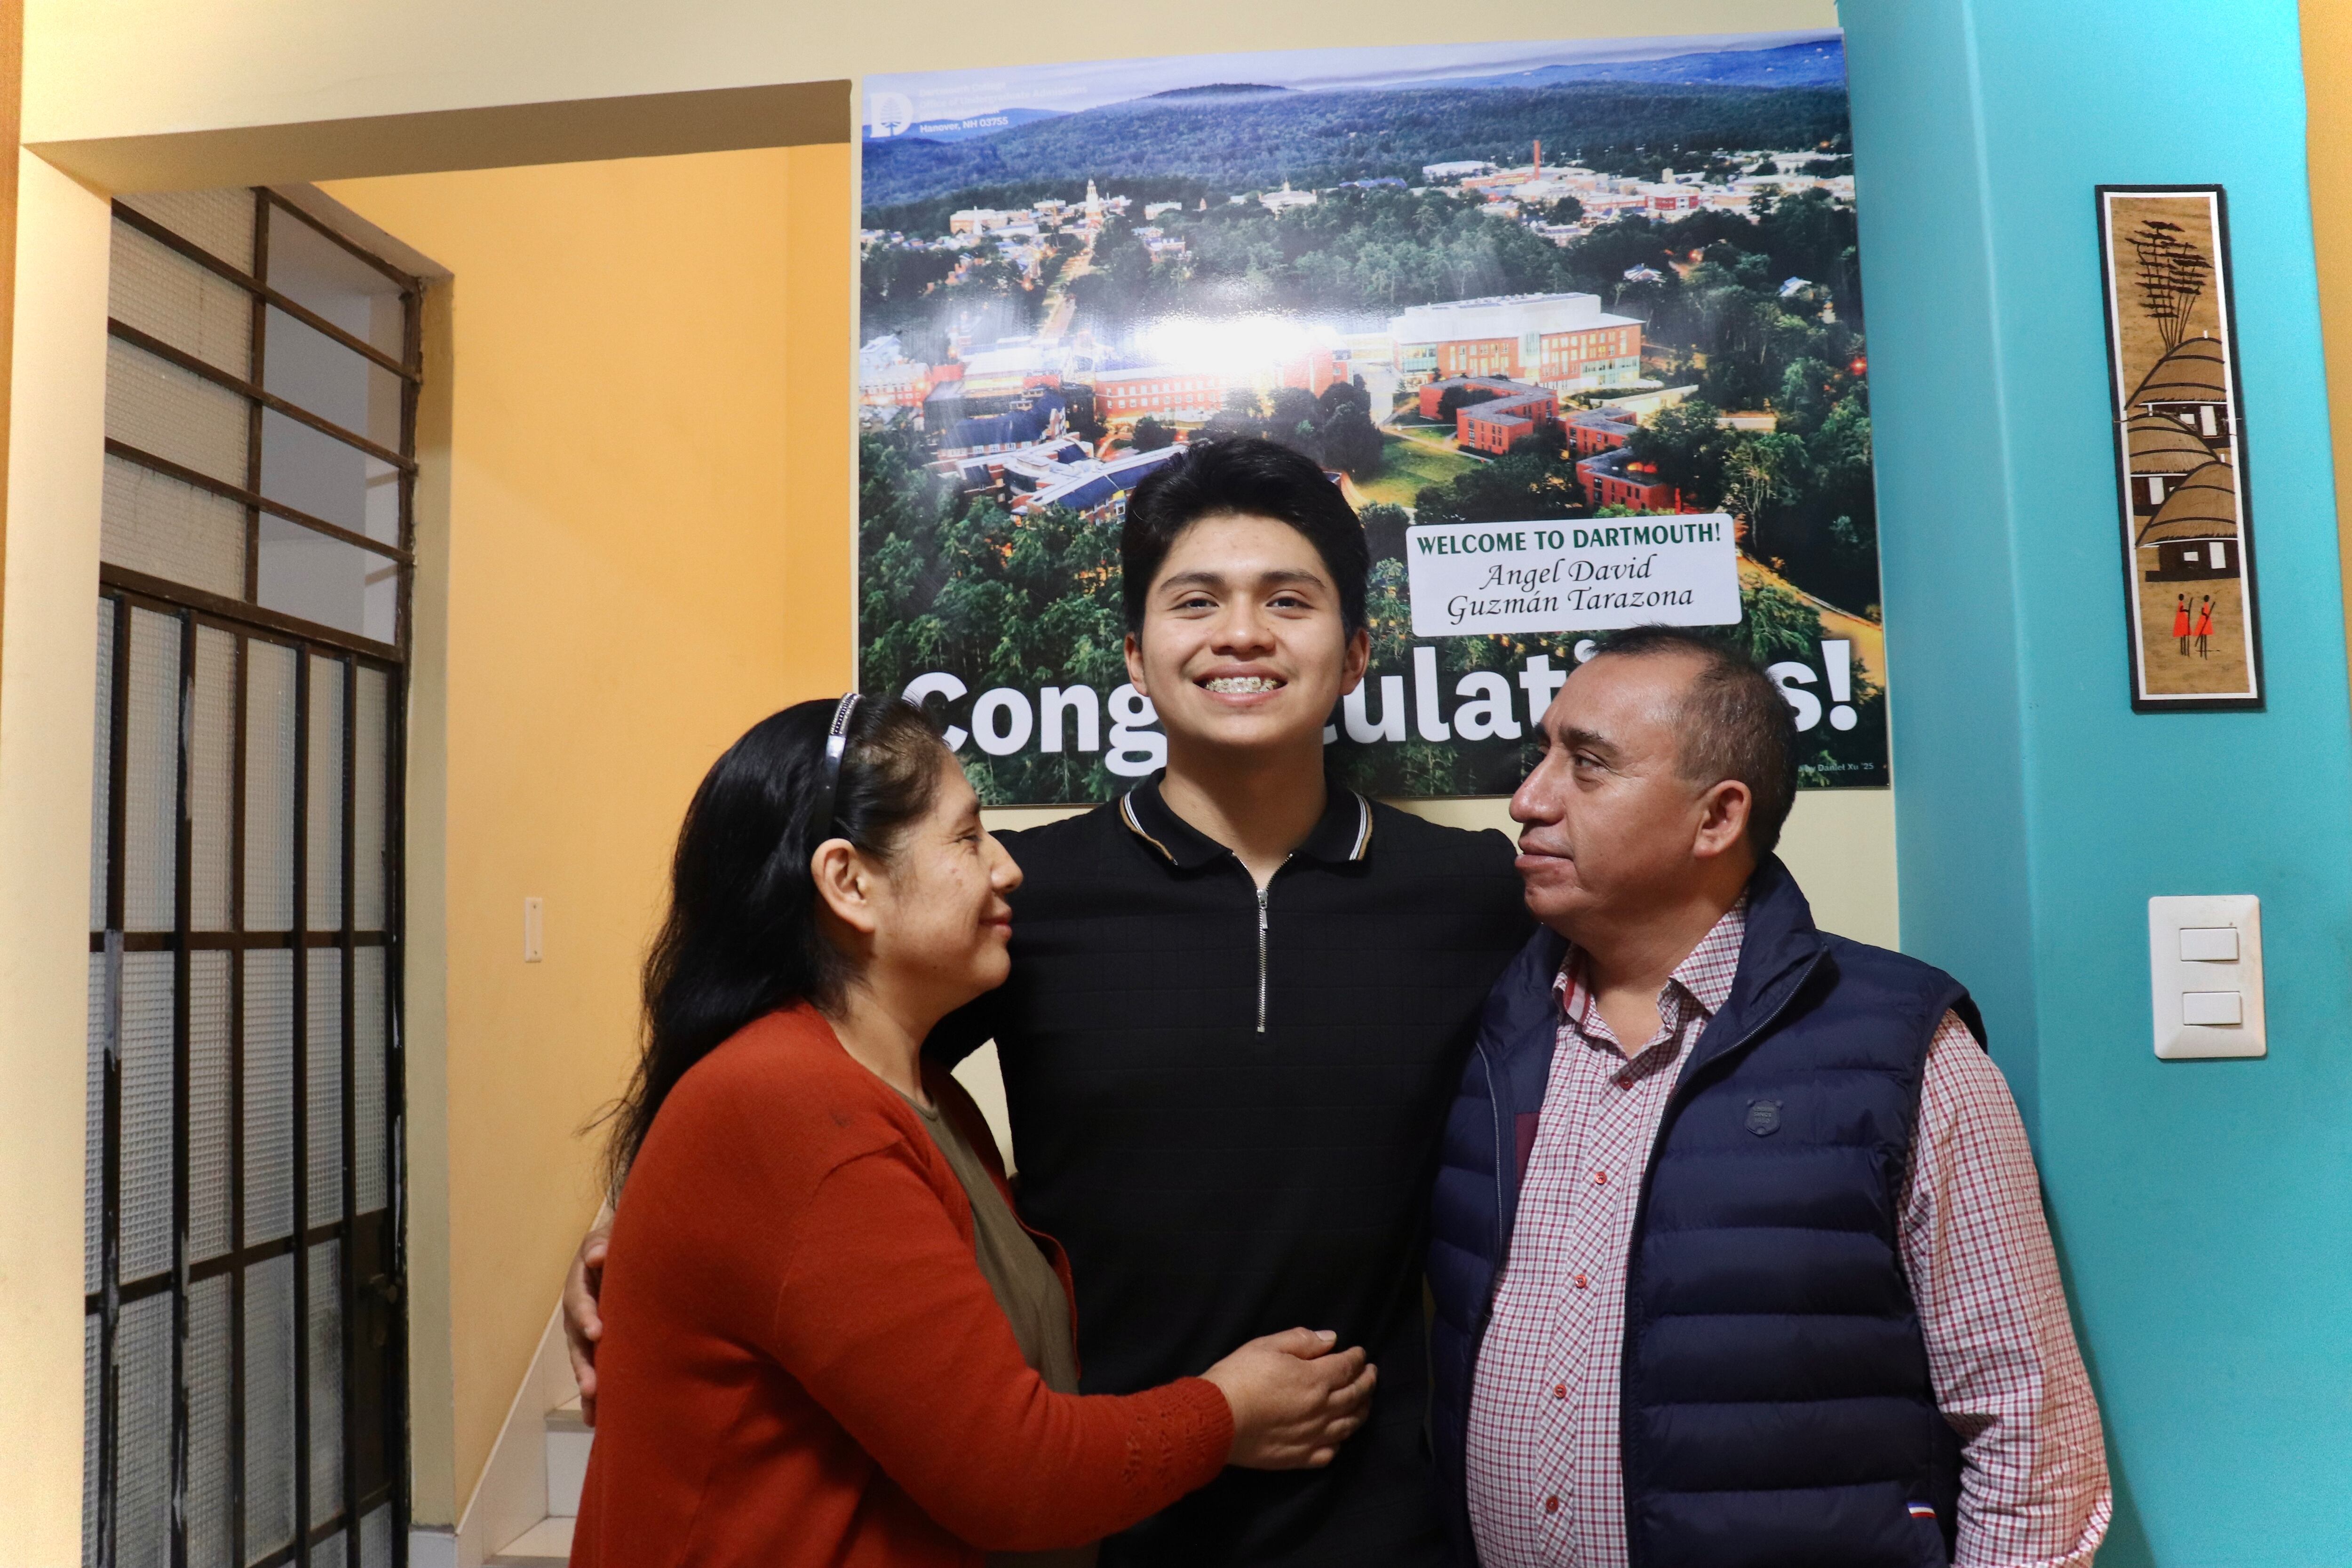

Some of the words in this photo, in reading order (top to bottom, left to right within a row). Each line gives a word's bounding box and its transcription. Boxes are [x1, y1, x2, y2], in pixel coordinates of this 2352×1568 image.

[920, 123, 961, 133] Hanover,
[963, 120, 977, 128] NH
[980, 117, 1008, 127] 03755
[1417, 532, 1526, 555] WELCOME
[1534, 530, 1564, 550] TO
[1574, 522, 1721, 548] DARTMOUTH!
[1479, 558, 1565, 592] Angel
[1568, 554, 1658, 582] David
[1447, 590, 1559, 625] Guzmán
[1567, 587, 1693, 611] Tarazona
